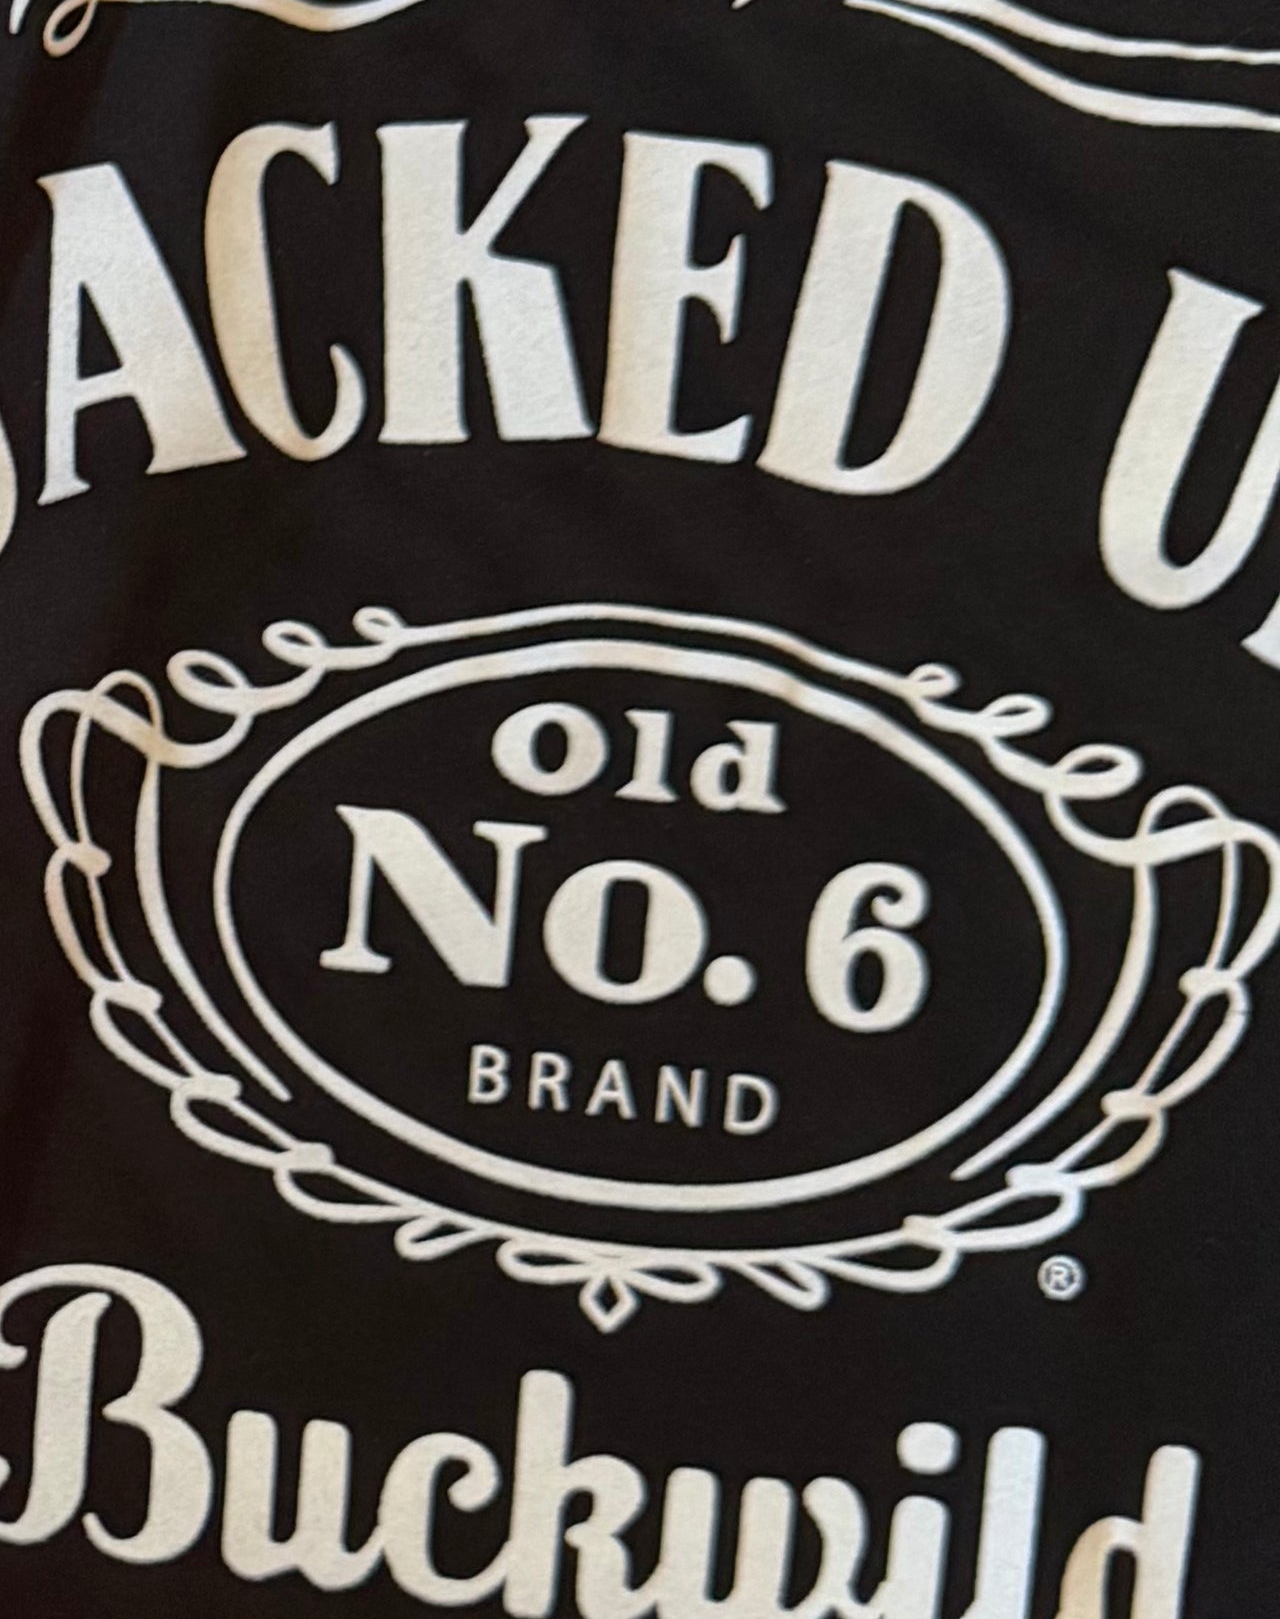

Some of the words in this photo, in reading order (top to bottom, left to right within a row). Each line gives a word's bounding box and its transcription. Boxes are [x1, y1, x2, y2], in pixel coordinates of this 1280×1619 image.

[1098, 268, 1280, 672] U
[492, 703, 785, 813] Old
[319, 804, 757, 1005] No.
[806, 863, 927, 1032] 6
[469, 1045, 776, 1134] BRAND
